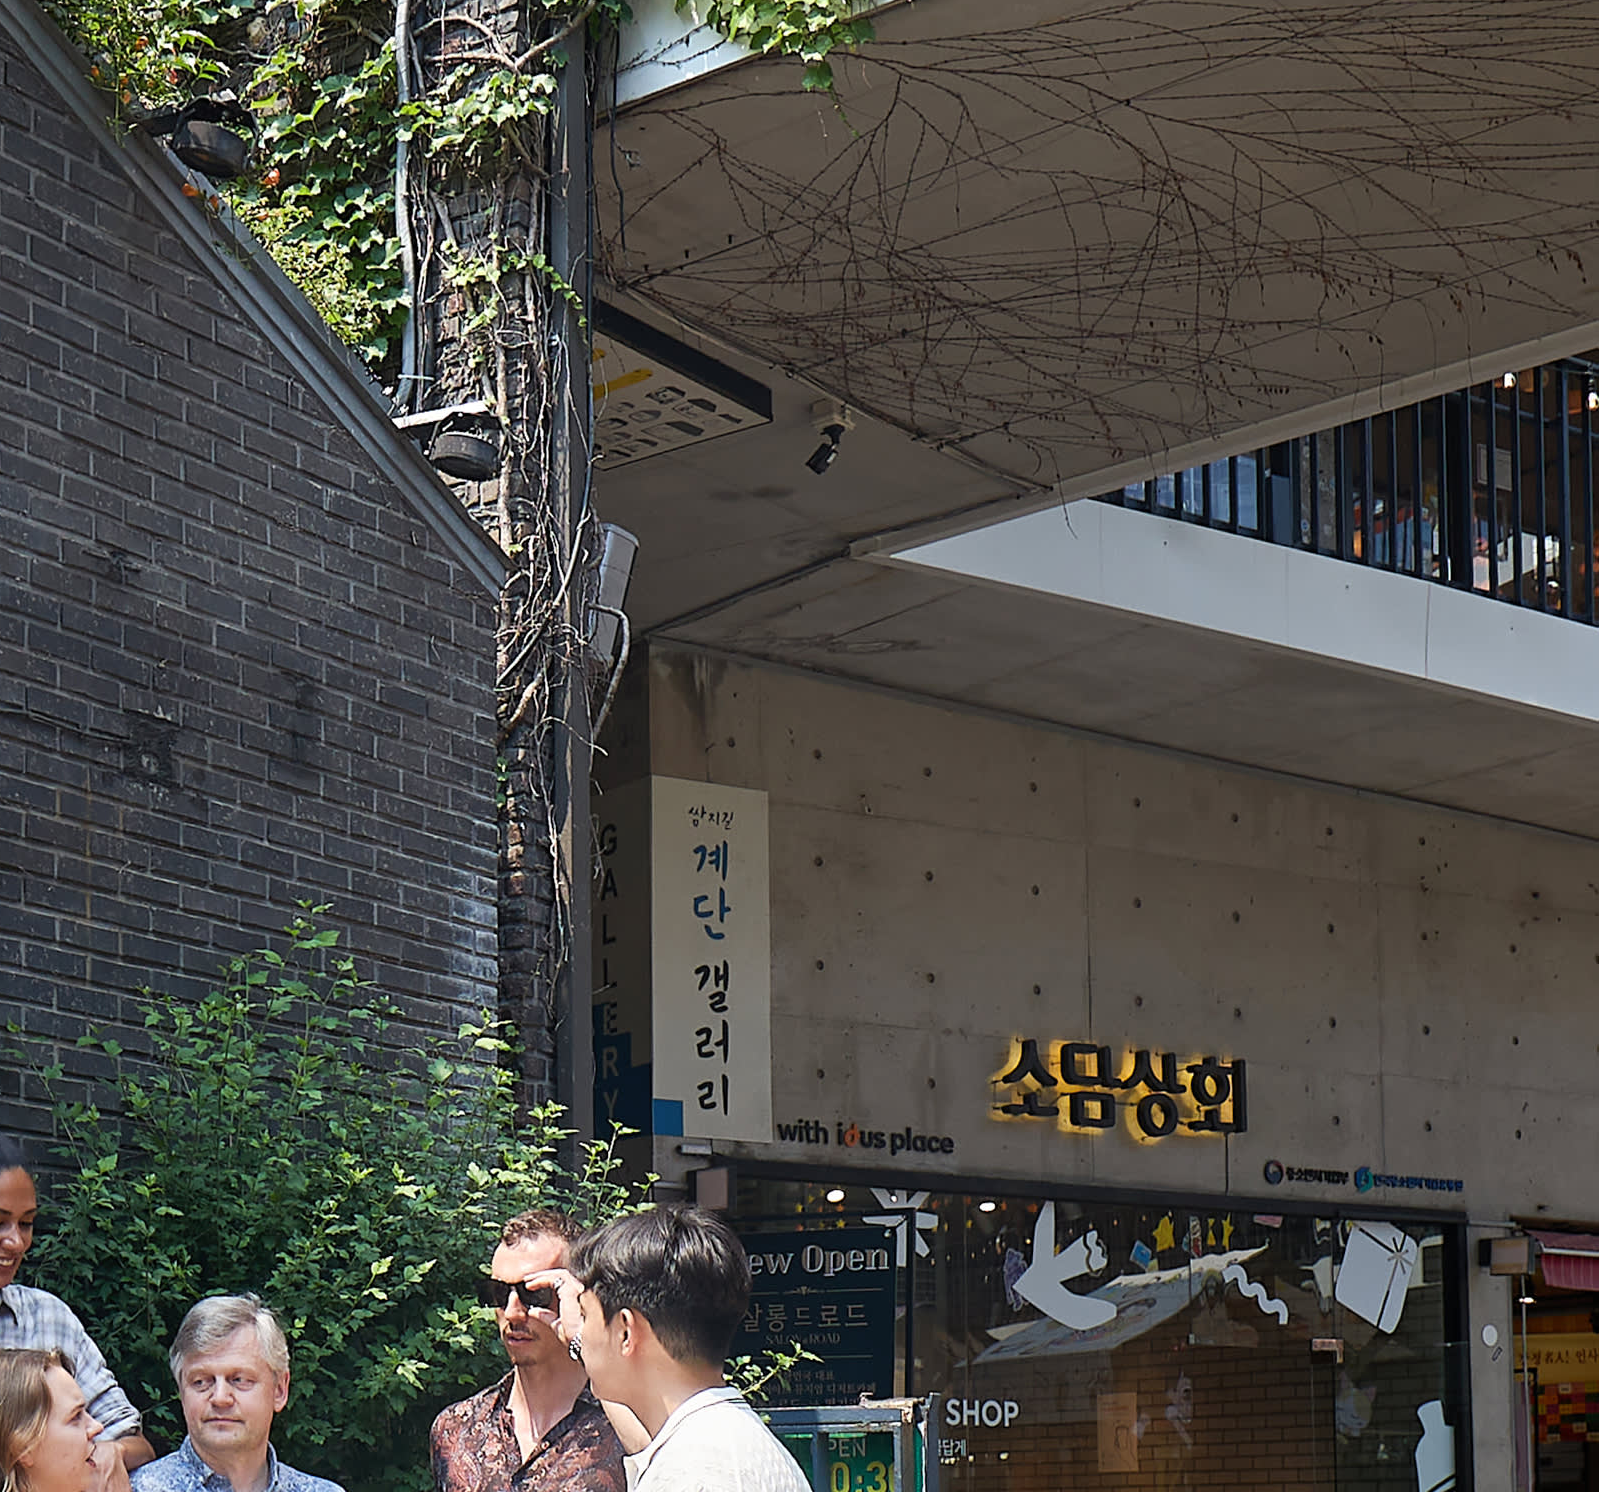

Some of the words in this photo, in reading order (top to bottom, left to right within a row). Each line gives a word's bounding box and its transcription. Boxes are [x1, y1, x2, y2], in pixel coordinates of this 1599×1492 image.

[693, 840, 732, 941] 계단
[694, 960, 730, 1117] 갤러리
[1001, 1038, 1249, 1137] 소담상회
[777, 1119, 829, 1146] with
[890, 1126, 955, 1157] place
[750, 1251, 795, 1276] ew
[801, 1244, 890, 1277] Open
[945, 1398, 1020, 1427] SHOP
